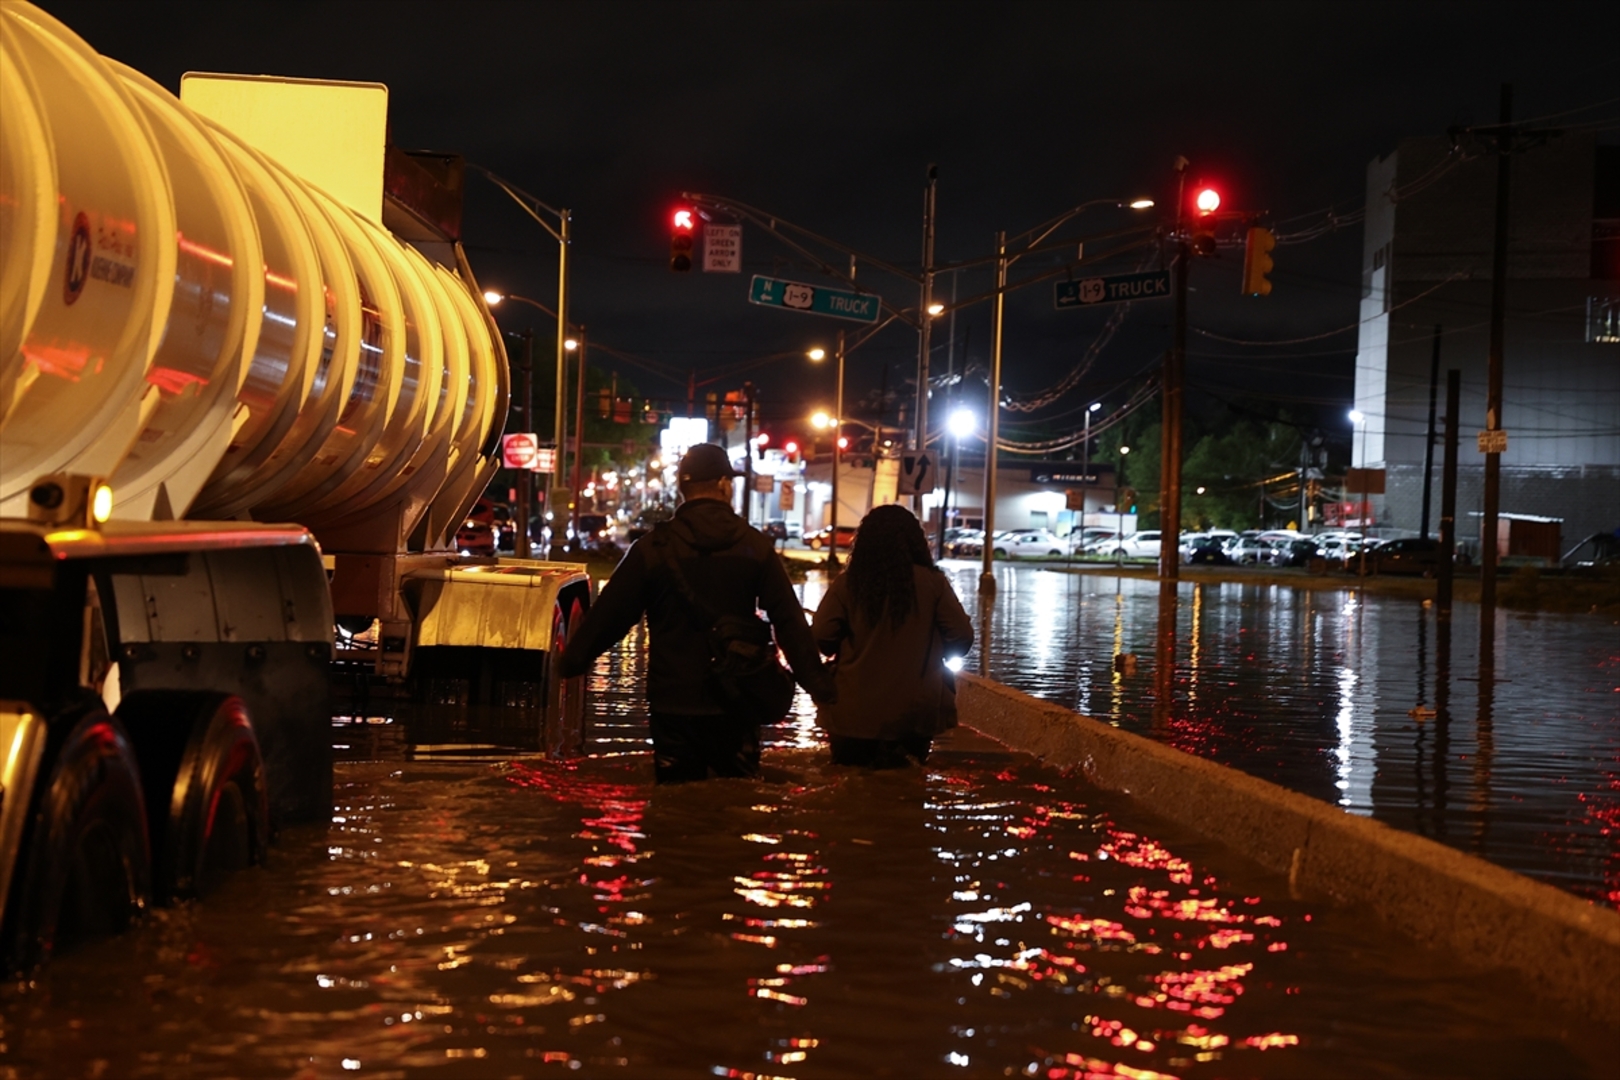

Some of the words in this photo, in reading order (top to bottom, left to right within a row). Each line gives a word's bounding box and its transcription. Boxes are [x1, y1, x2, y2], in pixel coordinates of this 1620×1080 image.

[706, 228, 724, 237] LEFT
[729, 229, 740, 237] ON
[711, 239, 735, 247] GREEN
[709, 249, 736, 257] ARROW
[712, 259, 732, 267] ONLY
[1083, 284, 1101, 298] 1-9
[1109, 278, 1166, 298] TRUCK
[763, 280, 772, 291] N
[788, 290, 808, 304] 1-9
[830, 296, 869, 314] TRUCK
